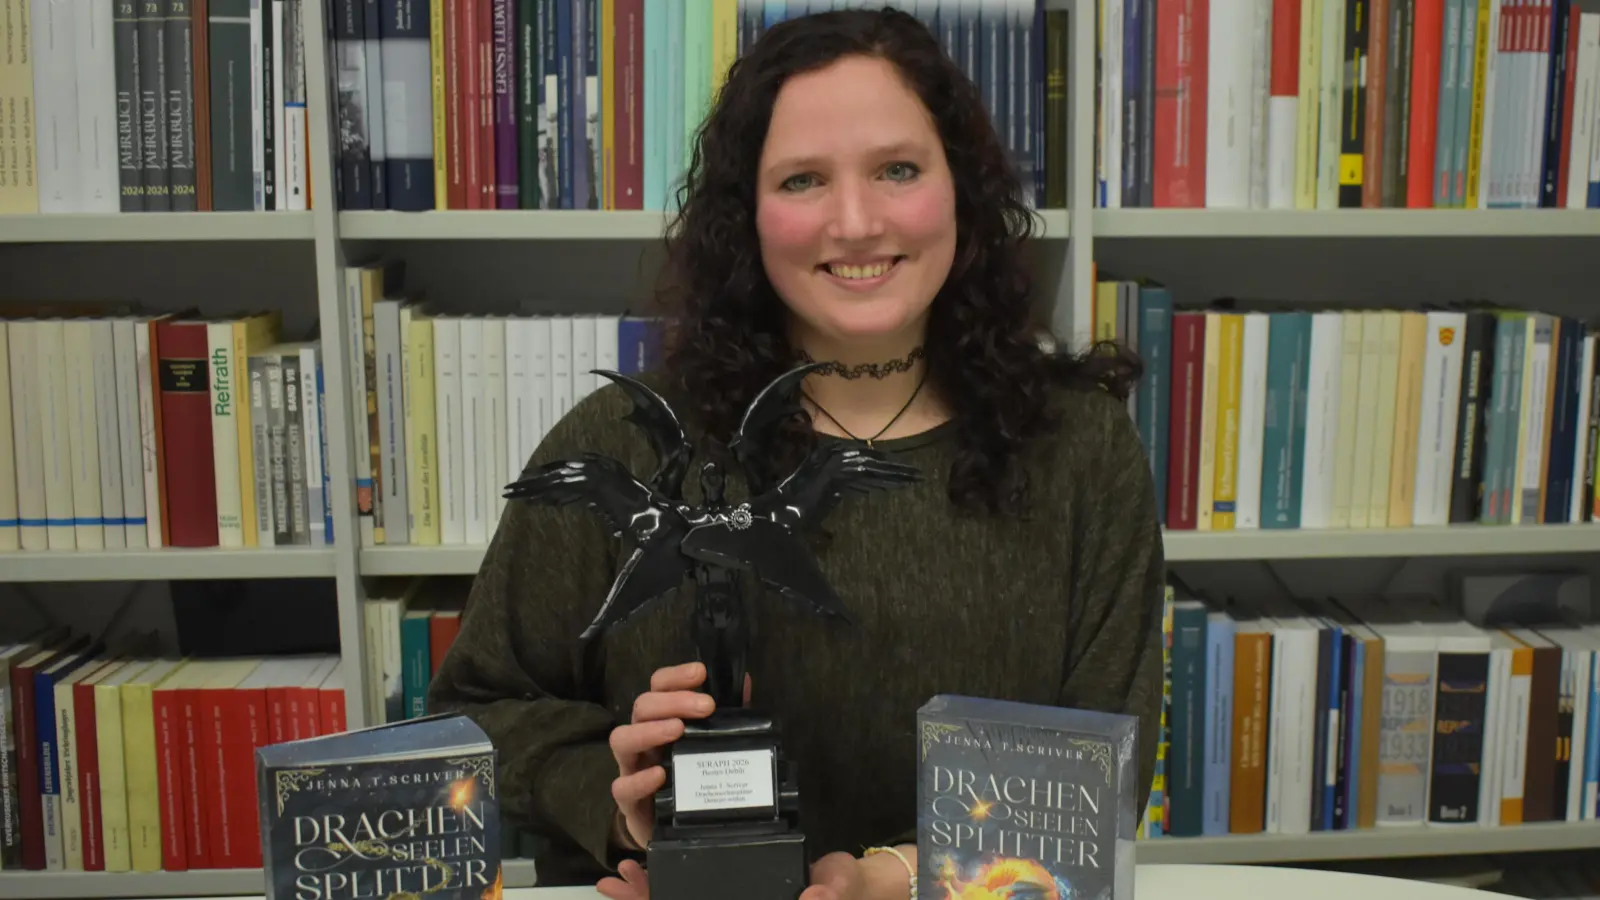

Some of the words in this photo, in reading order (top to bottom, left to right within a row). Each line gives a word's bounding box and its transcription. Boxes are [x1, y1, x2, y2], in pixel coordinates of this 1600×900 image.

[120, 4, 133, 14] 73
[145, 2, 158, 13] 73
[494, 46, 507, 94] ERNST
[118, 91, 136, 170] JAHRBUCH
[143, 90, 160, 169] JAHRBUCH
[170, 90, 187, 168] JAHRBUCH
[121, 185, 144, 196] 2024
[146, 185, 169, 196] 2024
[172, 184, 196, 194] 2024
[211, 347, 231, 416] Refrath
[1384, 688, 1430, 716] 1918
[946, 735, 992, 749] JENNA
[306, 778, 361, 791] JENNA
[932, 766, 1100, 815] DRACHEN
[3, 788, 13, 846] LEVERKUSENER
[294, 801, 485, 847] DRACHEN
[1014, 808, 1099, 838] SEELEN
[392, 836, 486, 862] SEELEN
[931, 820, 1100, 868] SPLITTER
[295, 859, 489, 900] SPLITTER
